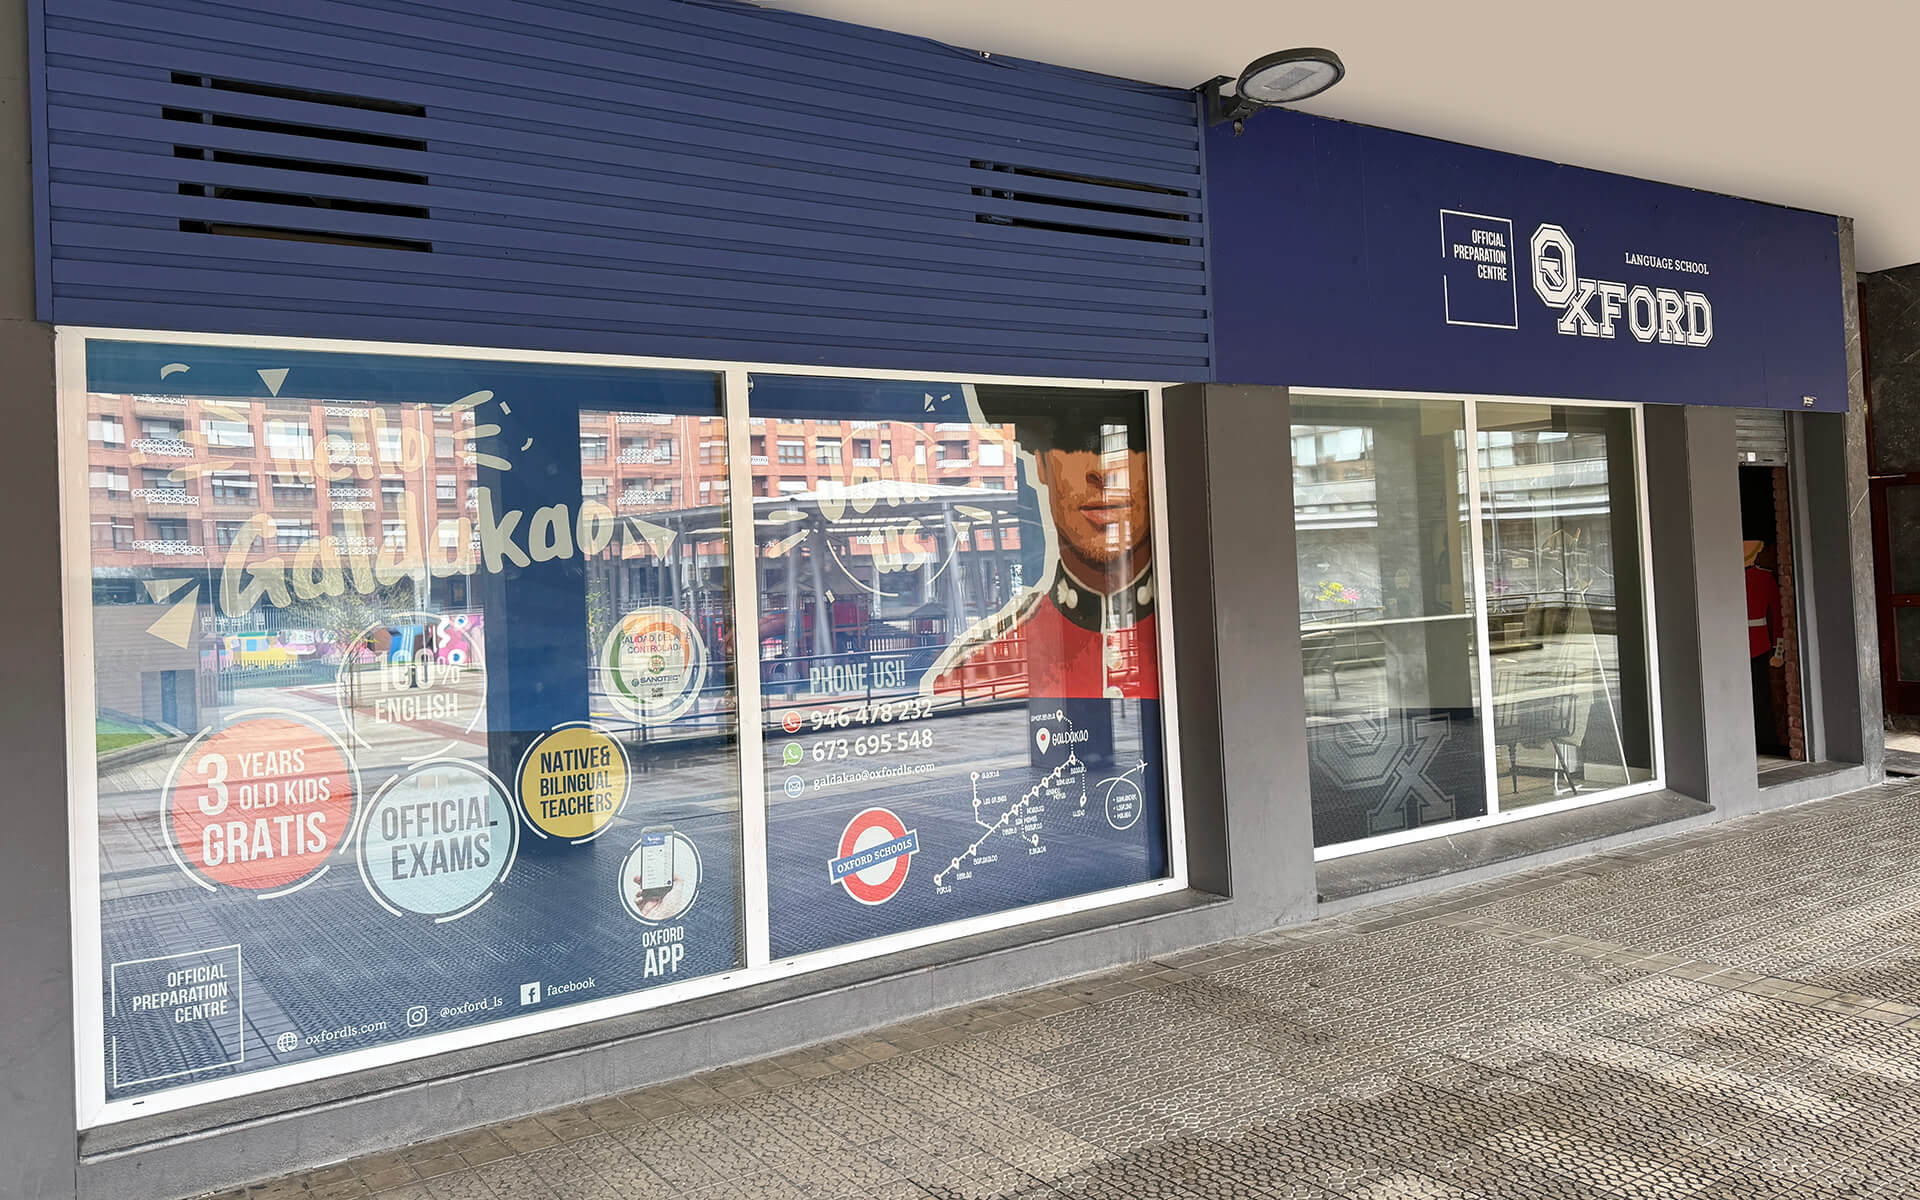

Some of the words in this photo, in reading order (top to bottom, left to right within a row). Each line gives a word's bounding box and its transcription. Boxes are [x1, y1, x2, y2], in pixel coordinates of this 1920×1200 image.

[1472, 229, 1506, 247] OFFICIAL
[1453, 244, 1507, 265] PREPARATION
[1625, 252, 1674, 270] LANGUAGE
[1674, 259, 1710, 276] SCHOOL
[1477, 263, 1508, 282] CENTRE
[1530, 223, 1714, 348] OXFORD
[219, 486, 615, 618] Galdakao
[376, 648, 461, 693] 100%
[809, 662, 869, 696] PHONE
[872, 659, 906, 689] US!!
[374, 693, 459, 724] ENGLISH
[810, 706, 850, 732] 946
[855, 702, 893, 725] 478
[898, 698, 934, 721] 232
[540, 745, 611, 774] NATIVE&
[811, 738, 849, 762] 673
[854, 733, 892, 756] 695
[897, 728, 934, 752] 548
[197, 753, 229, 816] 3
[237, 748, 305, 778] YEARS
[540, 770, 613, 797] BILINGUAL
[813, 761, 936, 791] galdakao@oxfordls.com
[240, 782, 279, 810] OLD
[284, 776, 331, 806] KIDS
[540, 791, 613, 819] TEACHERS
[381, 794, 499, 842] OFFICIAL
[202, 811, 328, 867] GRATIS
[391, 832, 491, 881] EXAMS
[836, 853, 874, 874] OXFORD
[873, 838, 913, 861] SCHOOLS
[642, 925, 685, 948] OXFORD
[167, 963, 229, 988] OFFICIAL
[643, 943, 685, 979] APP
[132, 981, 228, 1012] PREPARATION
[547, 976, 596, 997] facebook
[174, 999, 229, 1024] CENTRE
[439, 996, 503, 1018] @oxford_ls
[305, 1020, 387, 1046] oxfordls.com
